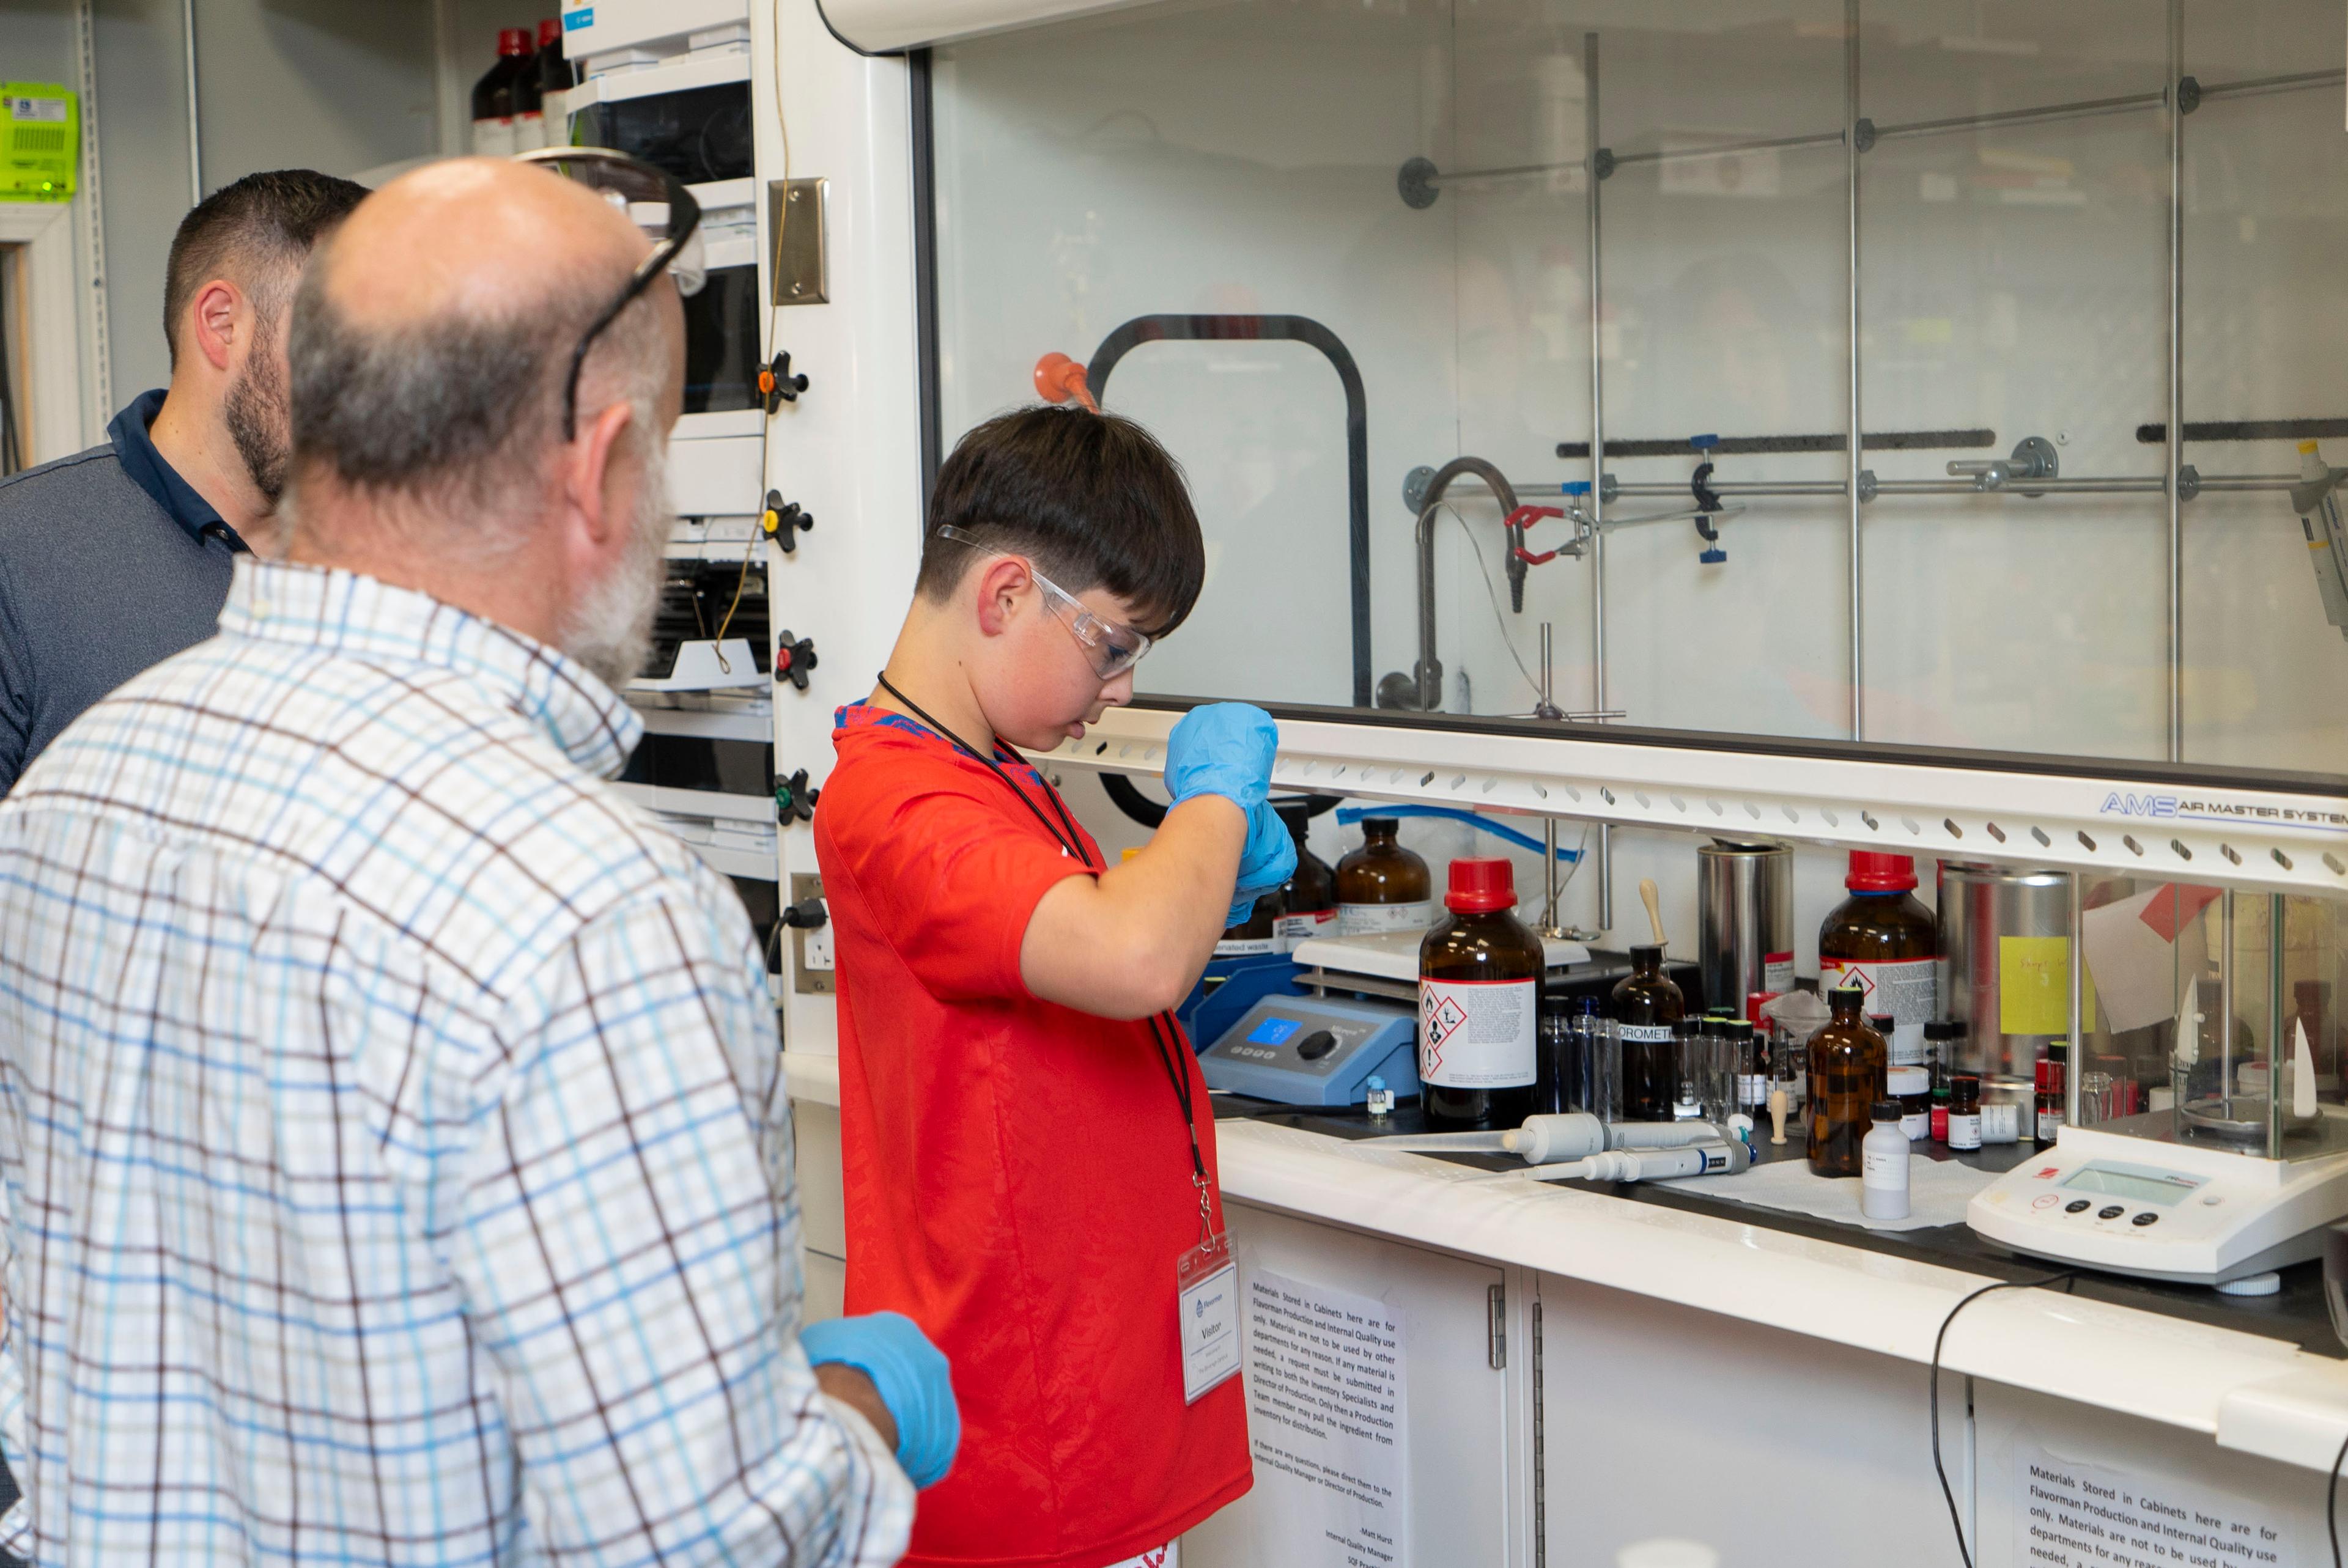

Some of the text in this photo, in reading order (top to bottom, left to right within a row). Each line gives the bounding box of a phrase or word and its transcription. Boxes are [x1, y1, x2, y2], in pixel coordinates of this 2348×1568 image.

[2100, 793, 2178, 817] AMS
[2179, 801, 2204, 812] AIR
[2208, 804, 2279, 817] MASTER
[1202, 1321, 1222, 1339] Visitor
[1253, 1283, 1395, 1332] Materials Stored in Cabinets here are for
[1253, 1298, 1395, 1349] Flavorman Production and Internal Quality use
[1253, 1314, 1268, 1326] only.
[1270, 1319, 1296, 1335] Materials
[1298, 1331, 1307, 1339] are
[1332, 1340, 1340, 1350] be
[1343, 1345, 1360, 1355] used
[1364, 1349, 1372, 1360] by
[1376, 1353, 1395, 1364] other
[1253, 1329, 1289, 1348] departments
[1301, 1346, 1310, 1357] any
[1312, 1350, 1334, 1364] reason.
[1336, 1357, 1340, 1366] If
[1343, 1361, 1355, 1372] any
[1357, 1366, 1387, 1379] material
[1390, 1371, 1395, 1380] is
[1253, 1345, 1277, 1360] needed,
[1288, 1358, 1310, 1371] request
[1314, 1366, 1329, 1378] must
[1334, 1373, 1341, 1382] be
[1346, 1378, 1381, 1394] submitted
[1388, 1387, 1394, 1397] in
[1253, 1361, 1394, 1413] writing to both the Inventory Specialists and
[1253, 1375, 1276, 1390] Director
[1285, 1386, 1316, 1405] Production.
[1319, 1399, 1332, 1412] Only
[1334, 1406, 1348, 1416] then
[1355, 1412, 1393, 1429] Production
[1254, 1390, 1393, 1446] Team member may pull the ingredient from
[1254, 1405, 1281, 1423] inventory
[1293, 1419, 1327, 1439] distribution.
[1254, 1452, 1273, 1465] Internal
[1275, 1460, 1293, 1474] Quality
[1294, 1468, 1316, 1482] Manager
[1325, 1479, 1345, 1492] Director
[1353, 1491, 1383, 1508] Production.
[1260, 1441, 1272, 1452] there
[1285, 1451, 1293, 1462] any
[1295, 1456, 1321, 1471] questions,
[1323, 1465, 1339, 1478] please
[1342, 1472, 1356, 1484] direct
[1357, 1478, 1372, 1490] them
[1382, 1487, 1392, 1497] the
[2030, 1465, 2277, 1541] Materials Stored in Cabinets here are for
[2030, 1485, 2276, 1562] Flavorman Production and Internal Quality use
[1326, 1529, 1393, 1562] Internal Quality Manager
[1348, 1556, 1357, 1566] SQF
[1377, 1534, 1392, 1545] Hurst
[2030, 1506, 2054, 1523] only.
[2059, 1514, 2104, 1537] Materials
[2110, 1531, 2125, 1544] are
[2132, 1537, 2148, 1550] not
[2154, 1544, 2165, 1555] to
[2171, 1547, 2184, 1561] be
[2190, 1555, 2216, 1568] used
[2030, 1525, 2092, 1553] departments
[2096, 1545, 2110, 1558] for
[2113, 1553, 2131, 1567] any
[2031, 1546, 2069, 1567] needed,
